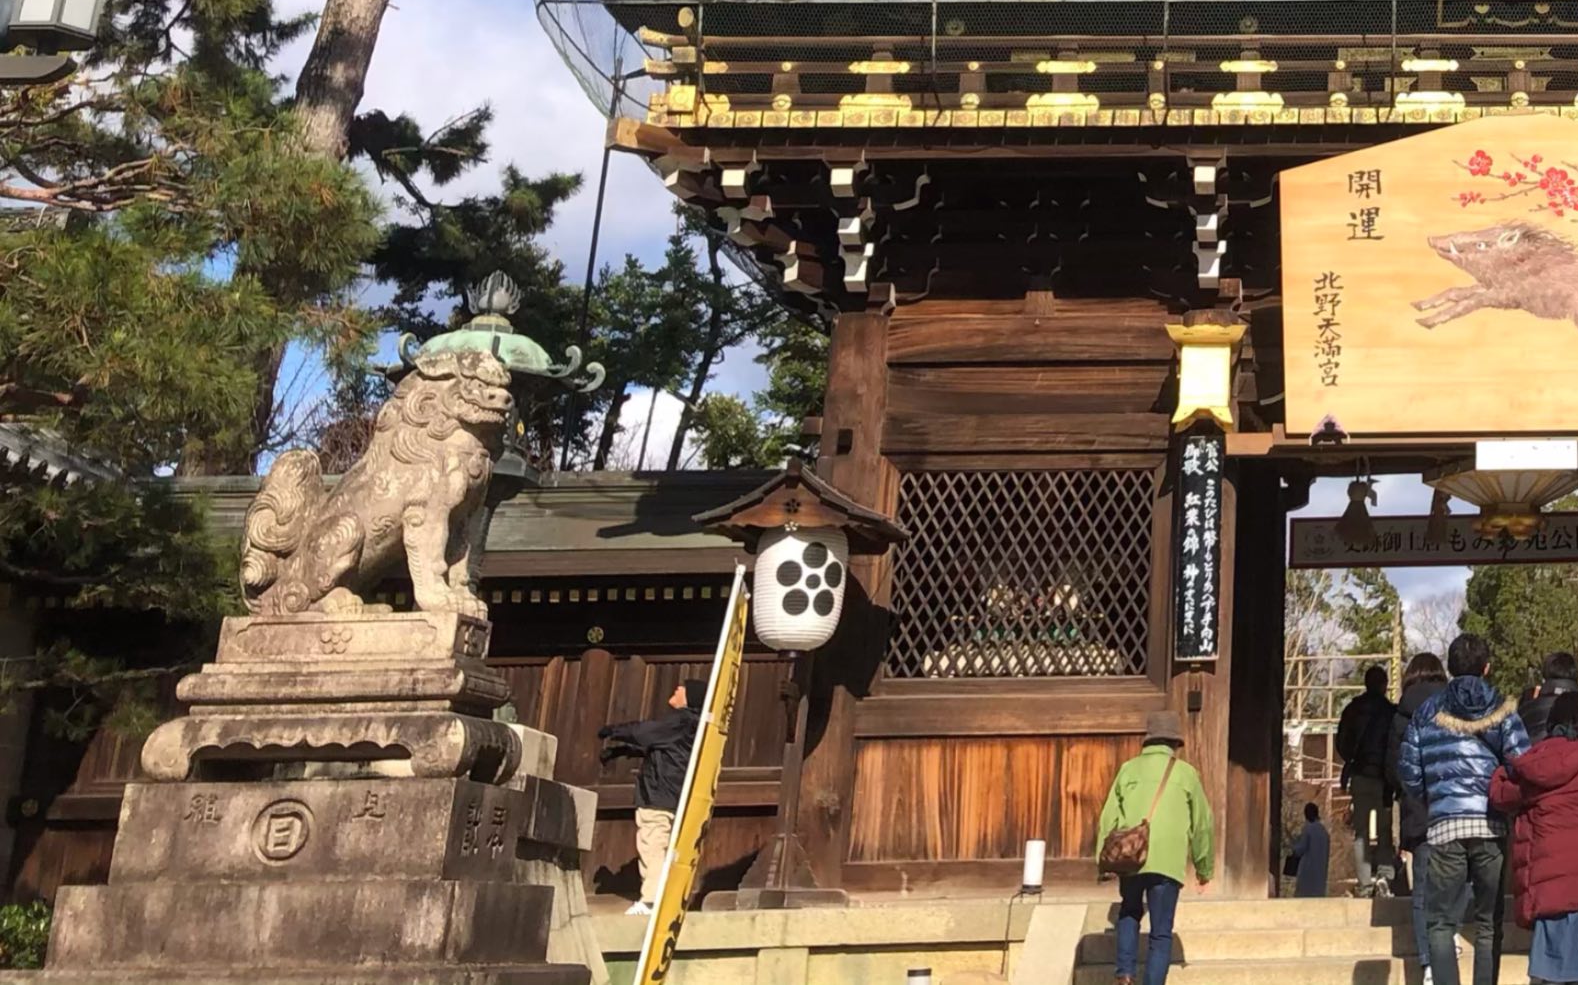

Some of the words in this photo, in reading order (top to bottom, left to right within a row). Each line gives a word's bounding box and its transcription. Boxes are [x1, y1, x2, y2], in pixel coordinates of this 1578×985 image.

[1346, 168, 1385, 241] 開運
[1313, 270, 1345, 387] 北野天満宮
